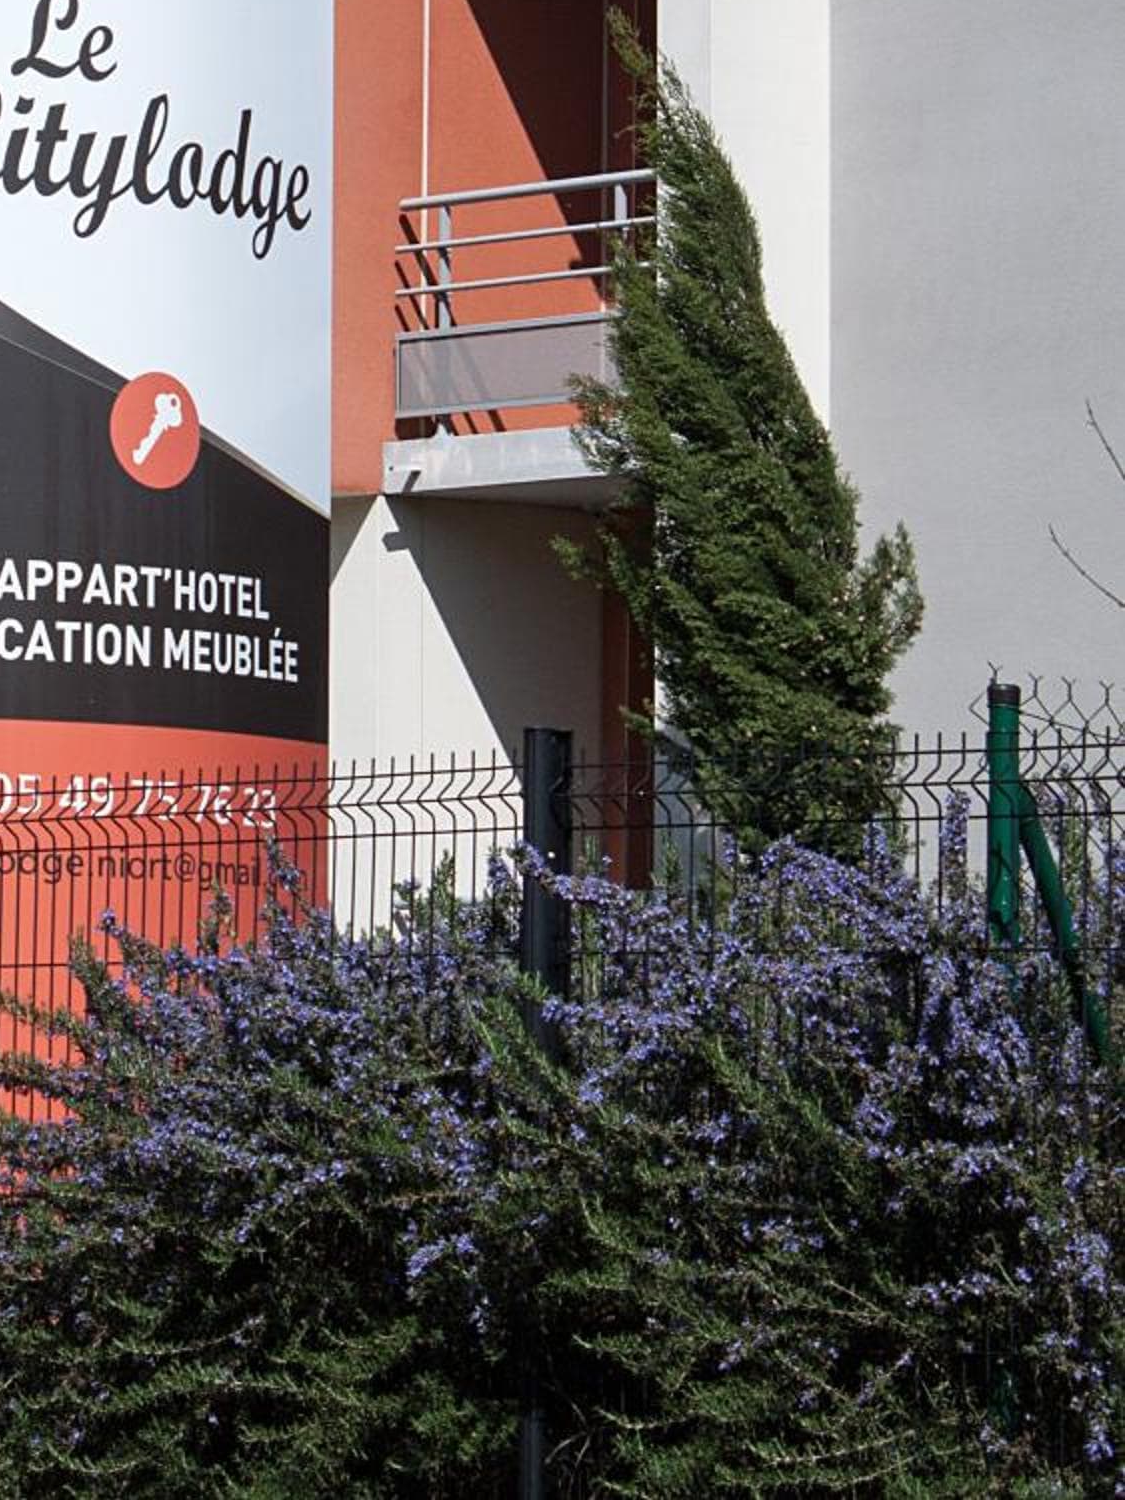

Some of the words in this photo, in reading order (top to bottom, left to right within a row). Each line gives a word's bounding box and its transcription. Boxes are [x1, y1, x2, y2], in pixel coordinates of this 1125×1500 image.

[164, 628, 299, 682] MEUBLÉE
[59, 775, 114, 817] 49
[130, 779, 179, 821] 75
